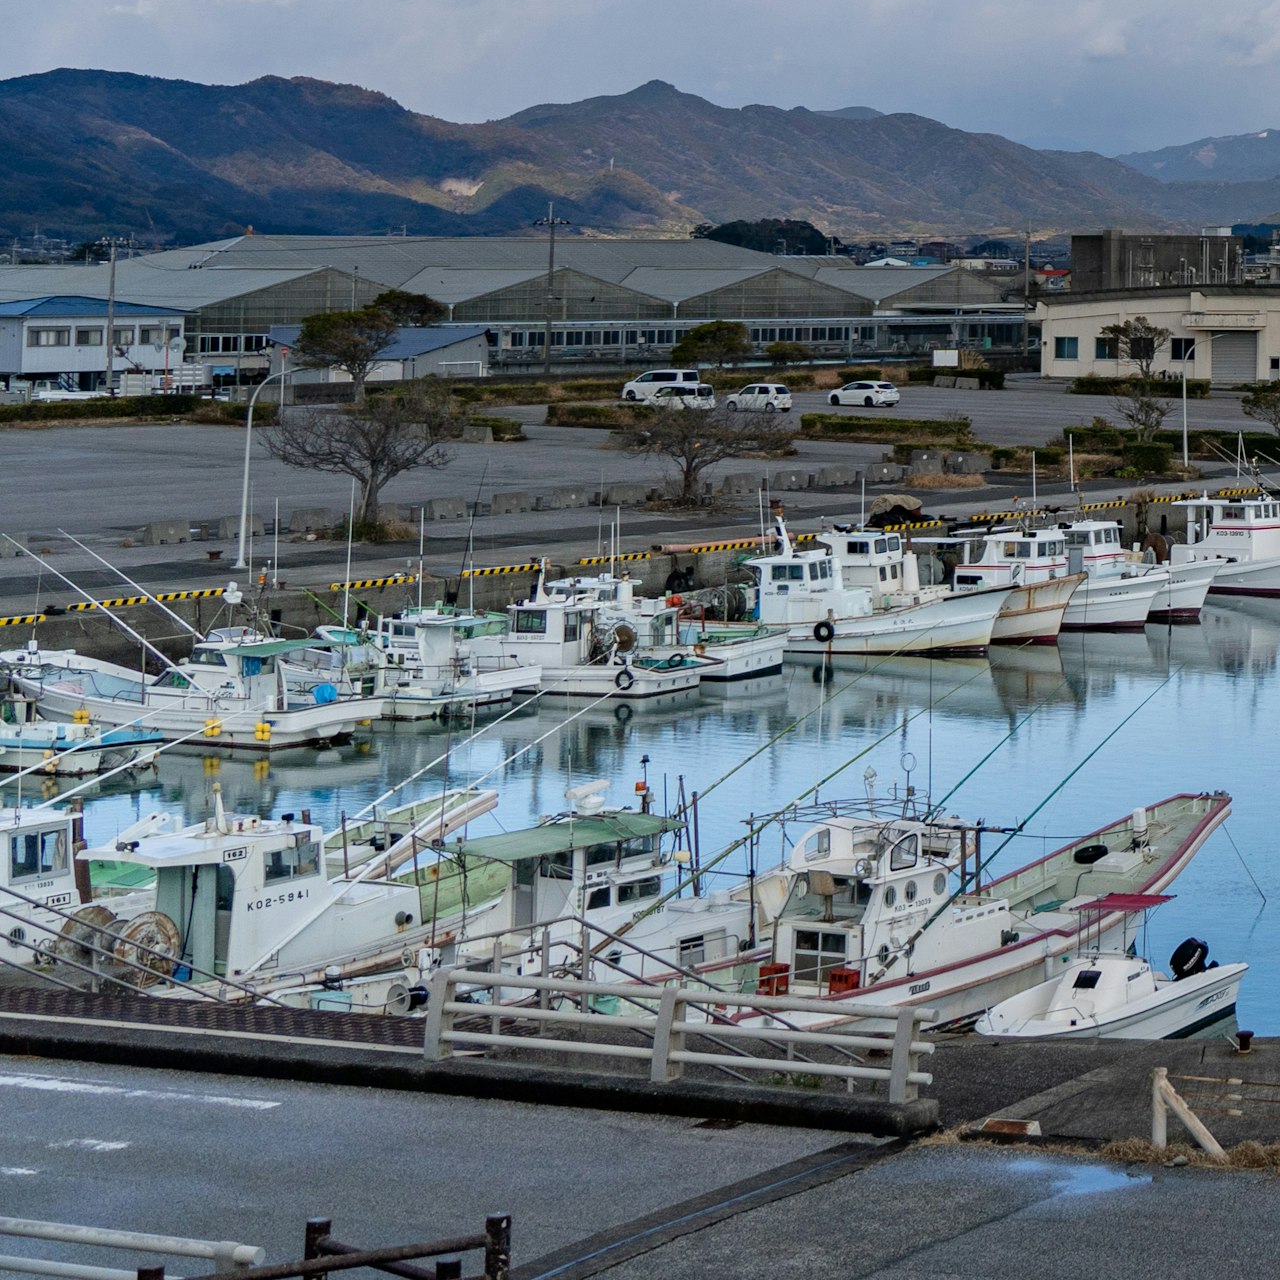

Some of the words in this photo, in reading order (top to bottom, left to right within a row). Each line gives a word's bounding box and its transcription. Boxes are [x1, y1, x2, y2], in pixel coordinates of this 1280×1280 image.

[227, 850, 244, 859] 162
[51, 896, 66, 904] 161
[247, 889, 309, 912] K02-5941
